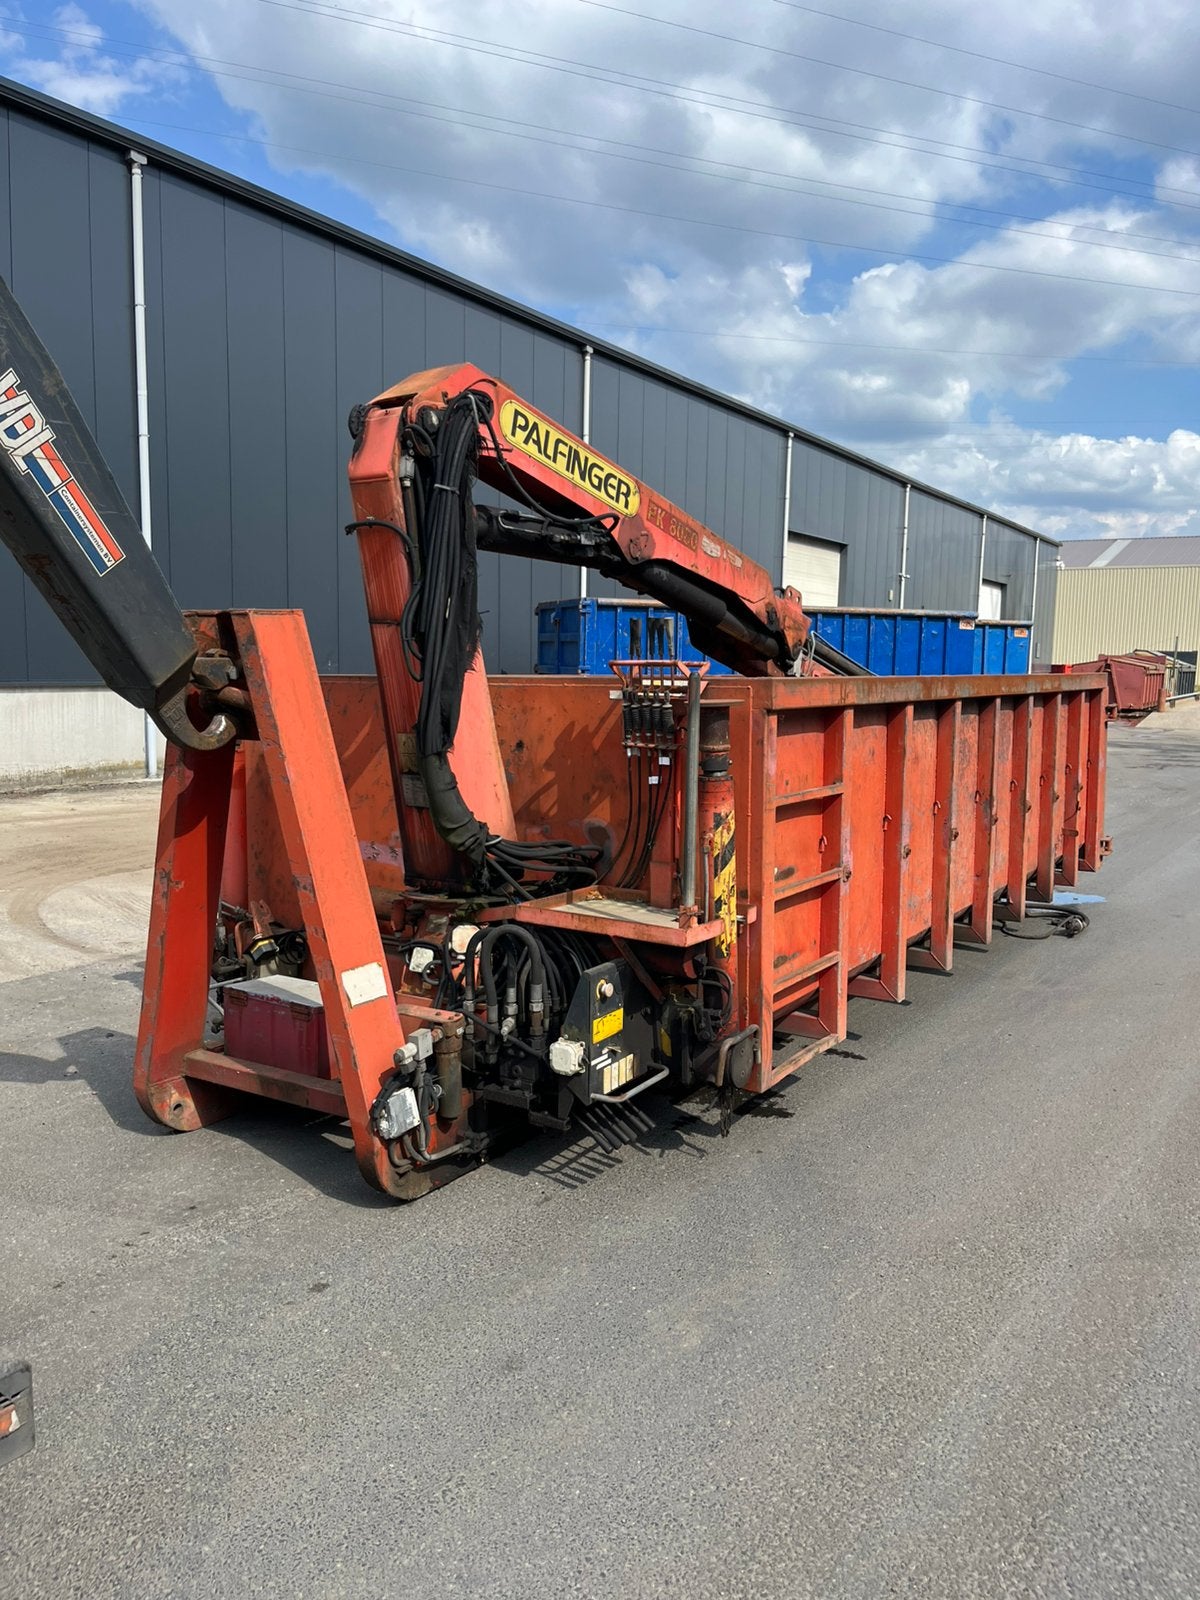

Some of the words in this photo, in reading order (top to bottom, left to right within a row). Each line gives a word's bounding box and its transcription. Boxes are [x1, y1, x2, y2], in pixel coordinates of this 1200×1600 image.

[511, 408, 632, 510] PALFINGER
[60, 489, 105, 554] Containersystemen
[103, 552, 113, 564] BV
